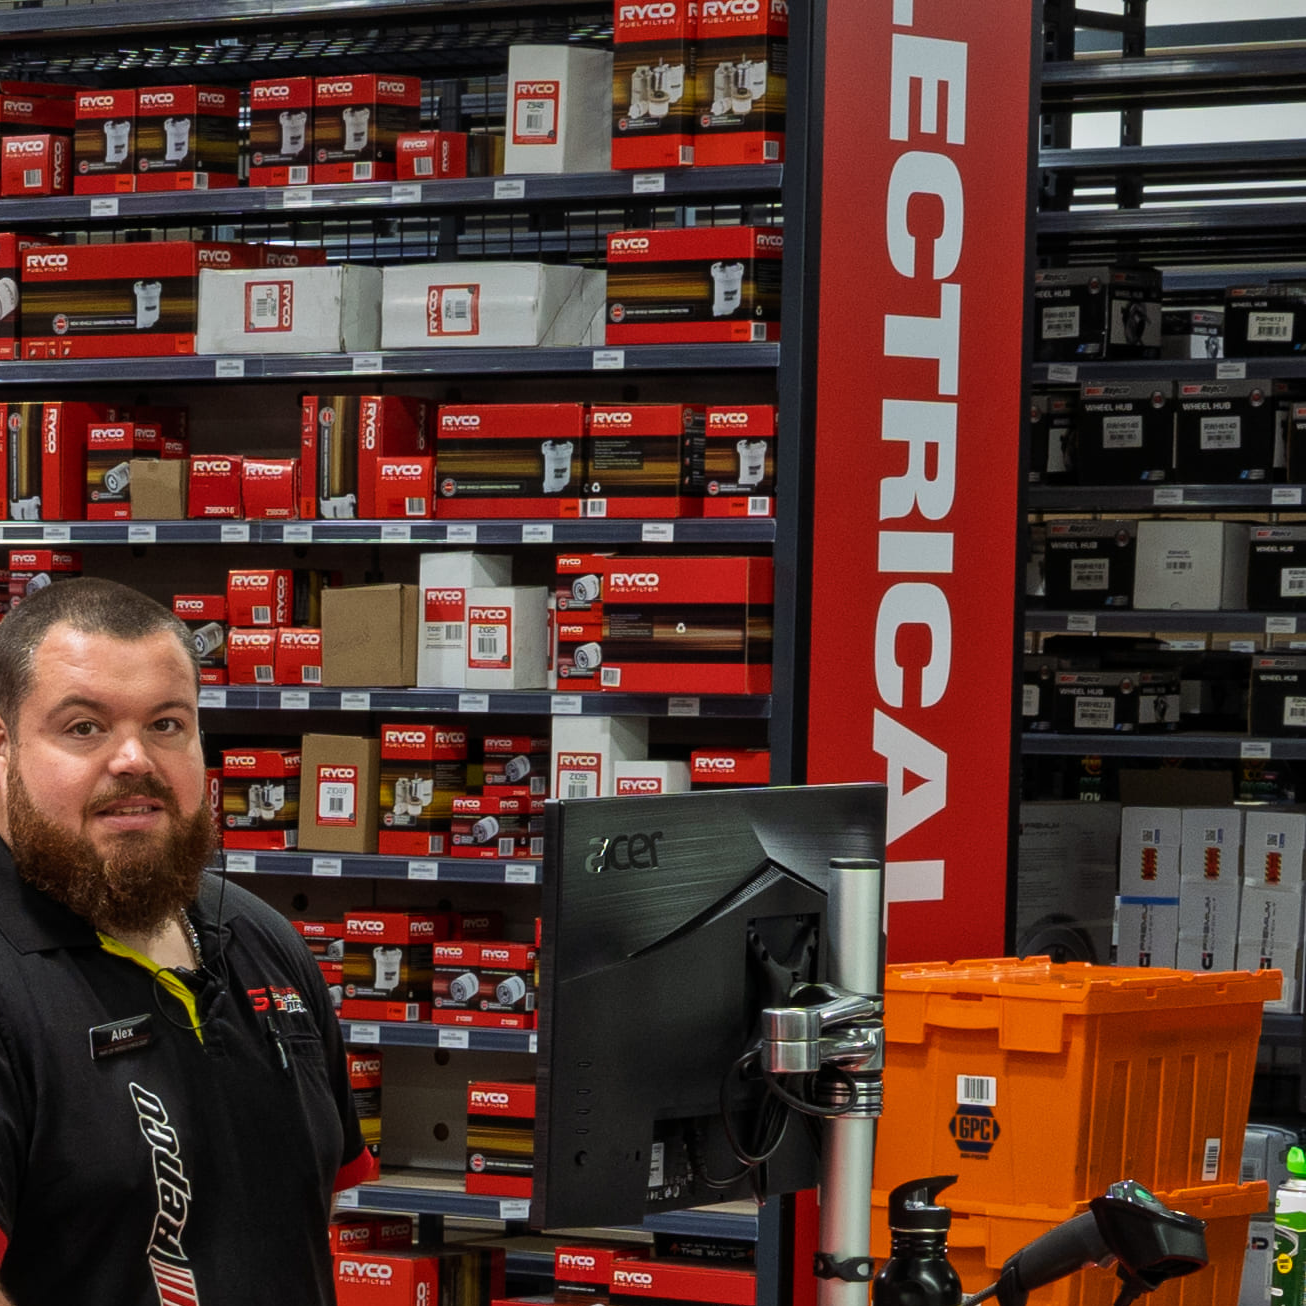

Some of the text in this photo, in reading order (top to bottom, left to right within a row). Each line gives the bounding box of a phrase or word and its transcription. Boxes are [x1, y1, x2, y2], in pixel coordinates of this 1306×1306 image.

[618, 2, 676, 22] RYCO
[516, 84, 555, 95] RYCO
[5, 140, 44, 154] RYCO
[610, 238, 649, 249] RYCO
[26, 254, 68, 269] RYCO
[872, 0, 969, 938] ECTRICAL
[610, 573, 659, 587] RYCO
[320, 767, 355, 779] RYCO
[585, 831, 663, 874] acer
[111, 1028, 134, 1042] Alex
[960, 1116, 990, 1140] GPC
[129, 1082, 192, 1259] Repco
[339, 1260, 392, 1279] RYCO
